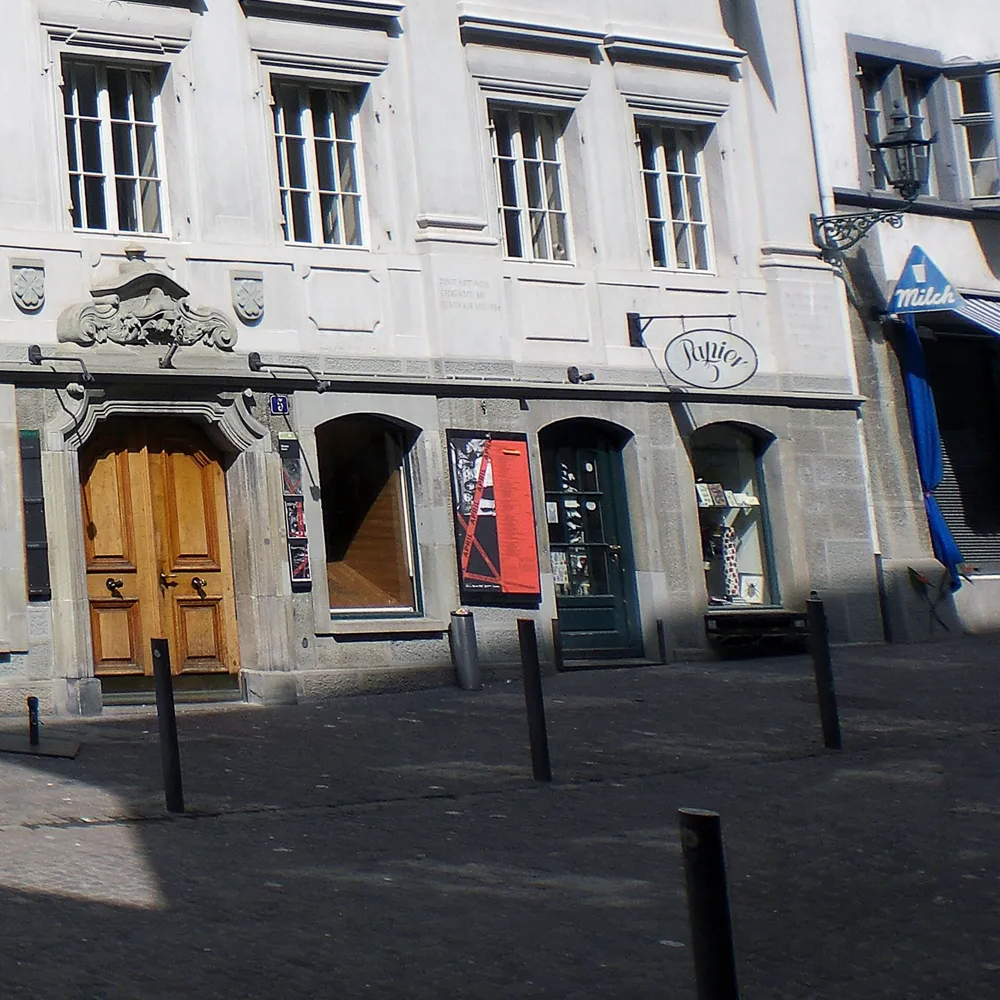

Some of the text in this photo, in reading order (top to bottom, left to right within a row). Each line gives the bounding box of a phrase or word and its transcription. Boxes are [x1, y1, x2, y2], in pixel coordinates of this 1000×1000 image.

[895, 285, 955, 307] Milch
[677, 339, 748, 382] Papier
[277, 398, 284, 412] 5
[470, 501, 479, 525] APRIL
[463, 534, 473, 557] APRIL
